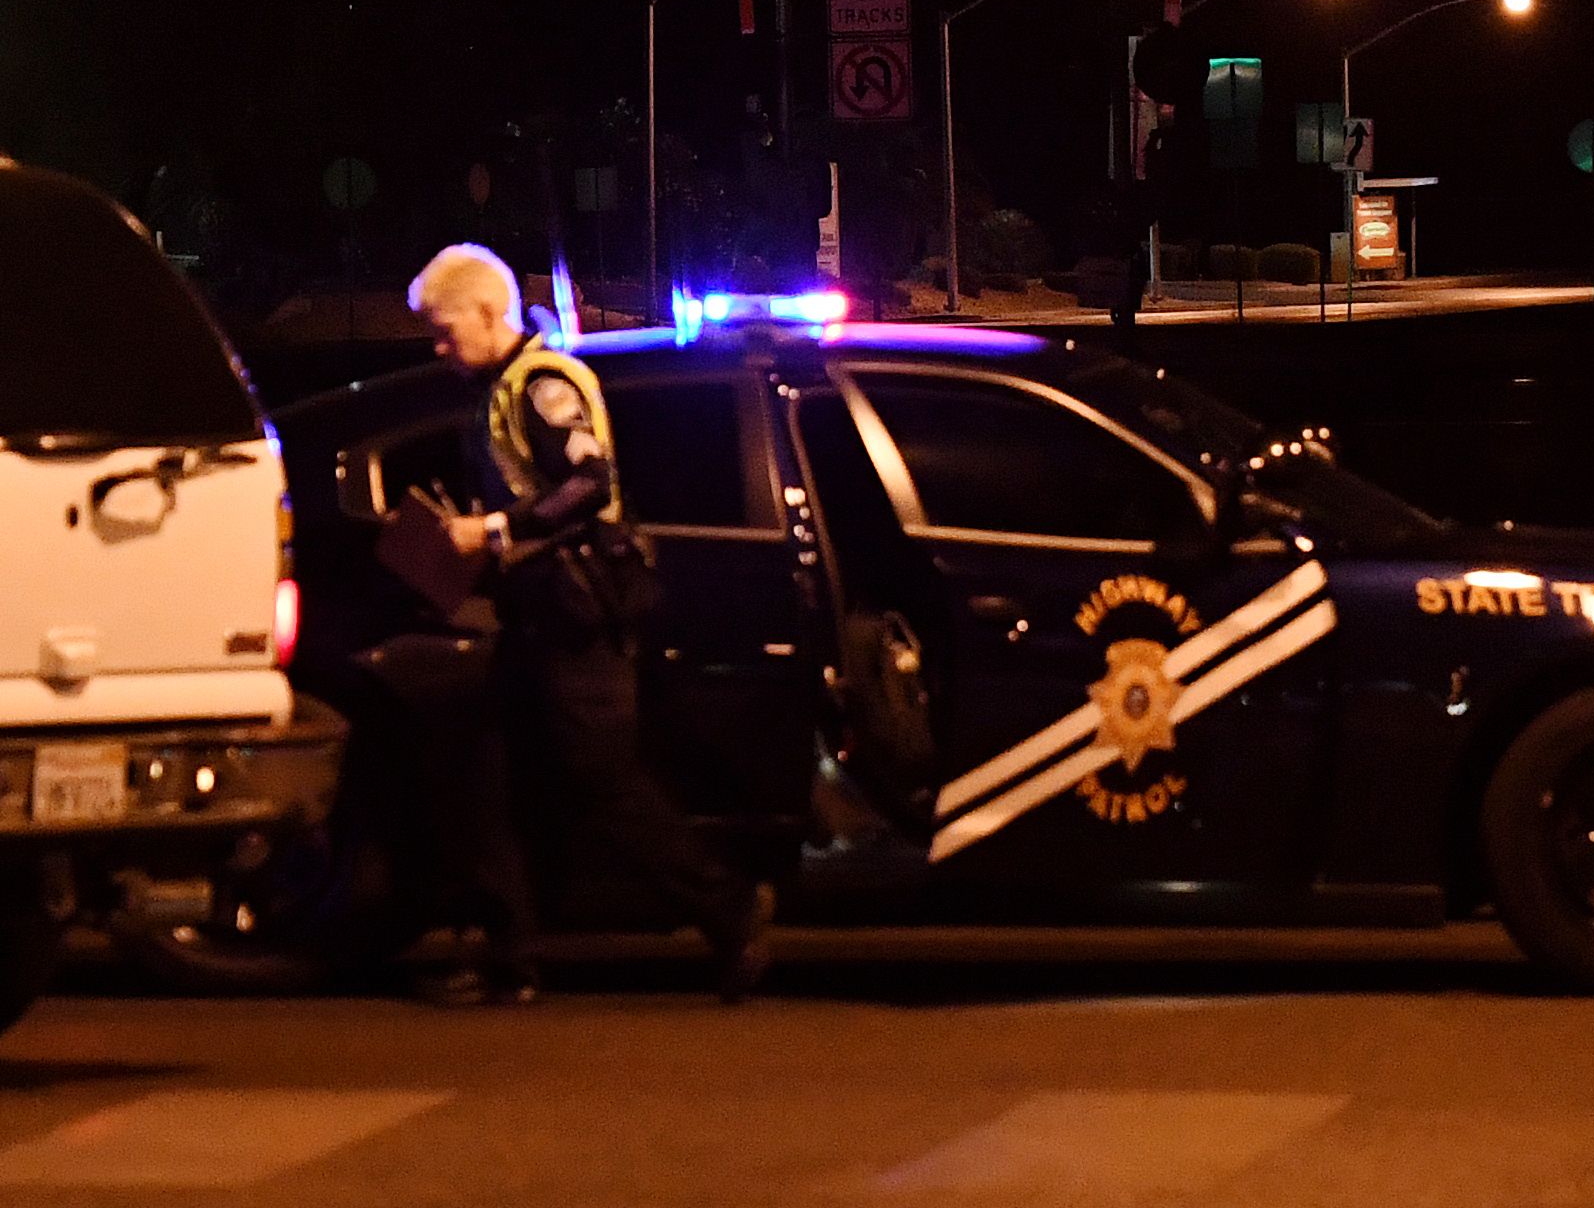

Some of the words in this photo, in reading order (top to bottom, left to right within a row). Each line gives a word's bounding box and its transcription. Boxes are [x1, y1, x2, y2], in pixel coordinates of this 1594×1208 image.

[836, 6, 904, 27] TRACKS
[1074, 574, 1201, 636] HIGHWAY
[1415, 577, 1547, 616] STATE
[1076, 772, 1188, 824] PATROL
